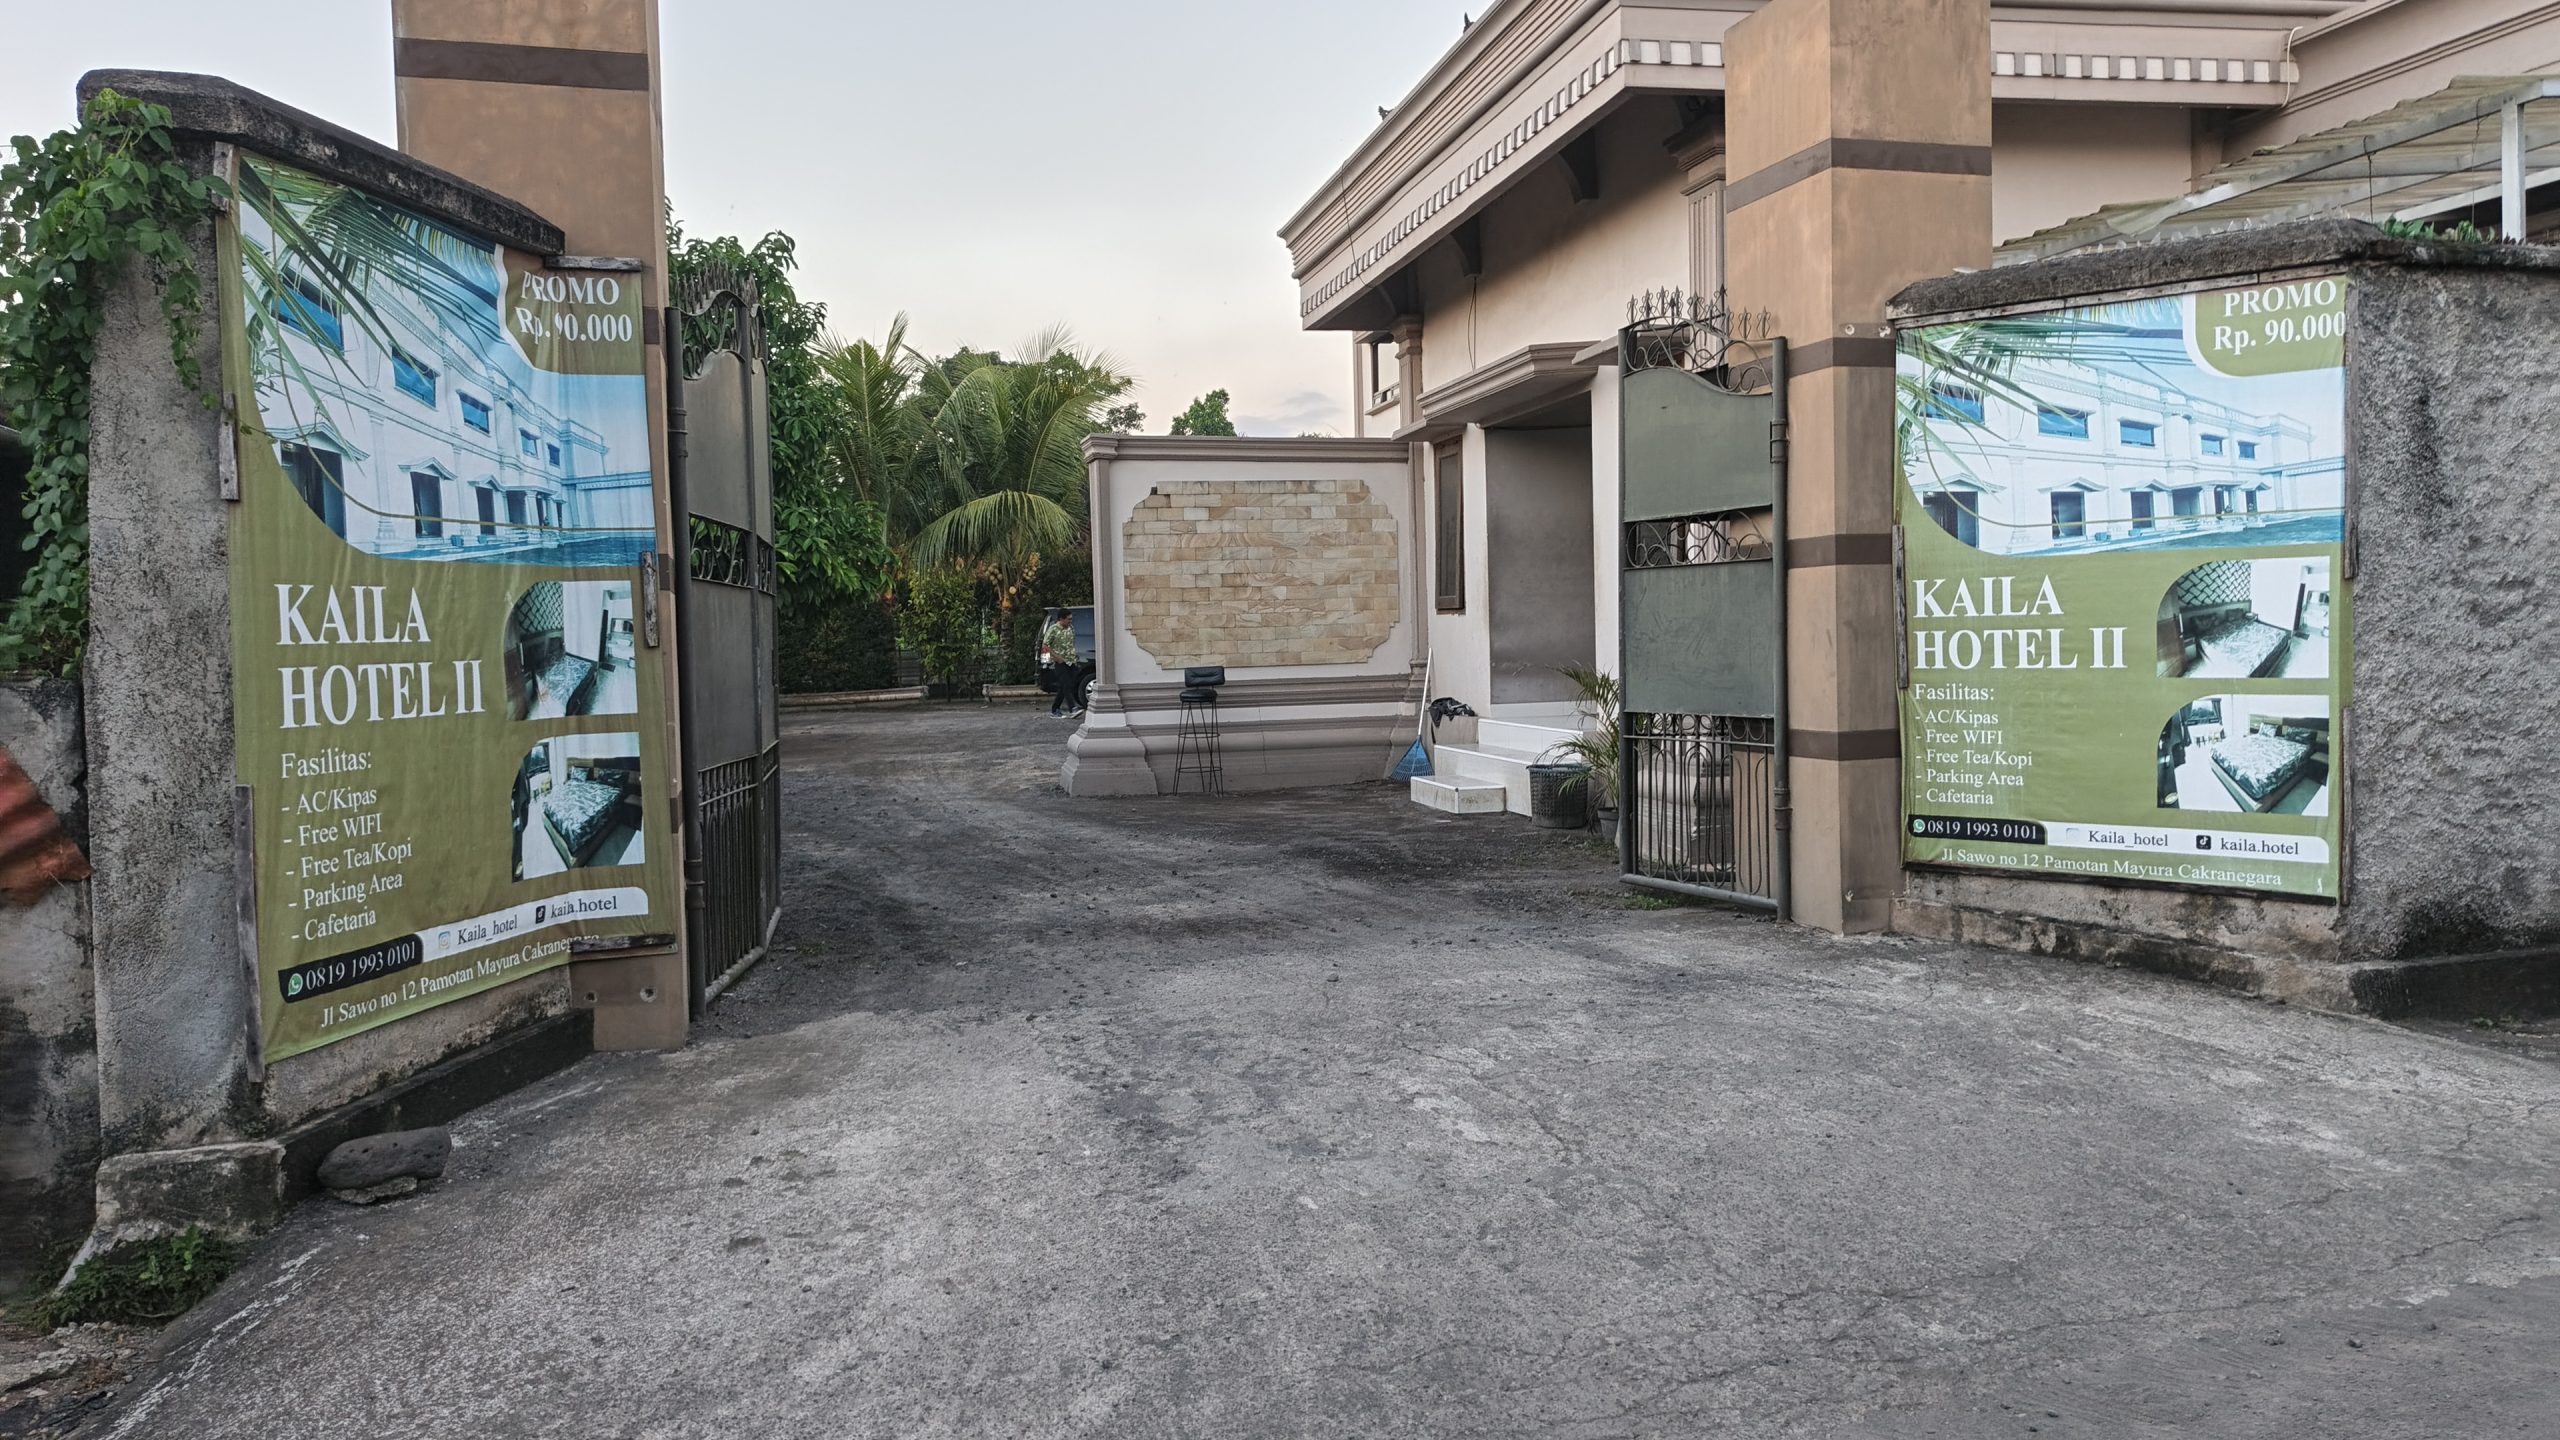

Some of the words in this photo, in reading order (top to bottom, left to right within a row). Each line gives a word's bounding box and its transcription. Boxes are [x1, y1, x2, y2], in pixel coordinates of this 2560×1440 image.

[521, 270, 620, 305] PROMO
[2223, 279, 2337, 317] PROMO
[514, 307, 551, 344] Rp.
[554, 312, 633, 342] 90.000
[2213, 325, 2257, 355] Rp.
[2264, 311, 2347, 345] 90.000
[1912, 574, 2065, 619] KAILA
[274, 583, 431, 646] KAILA
[1913, 627, 2078, 670] HOTEL
[2089, 626, 2128, 669] II
[277, 661, 446, 729] HOTEL
[452, 659, 486, 715] II
[1914, 683, 1995, 701] Fasilitas:
[1925, 709, 1999, 727] AC/Kipas
[1926, 729, 1958, 743] Free
[1963, 729, 2003, 745] WIFI
[281, 747, 372, 779] Fasilitas:
[1926, 749, 1959, 763] Free
[1962, 749, 2033, 769] Tea/Kopi
[1927, 768, 1984, 788] Parking
[1987, 771, 2024, 786] Area
[296, 786, 377, 815] AC/Kipas
[1926, 787, 1994, 805] Cafetaria
[298, 824, 339, 847] Free
[342, 812, 383, 838] WIFI
[1927, 819, 1961, 835] 0819
[1966, 822, 1999, 837] 1993
[2003, 824, 2037, 840] 0101
[2088, 830, 2169, 848] Kaila_hotel
[2220, 837, 2299, 855] kaila.hotel
[301, 856, 340, 879] Free
[343, 836, 412, 870] Tea/Kopi
[1957, 849, 1996, 864] Sawo
[1999, 855, 2018, 866] no
[2023, 854, 2039, 868] 12
[2044, 856, 2109, 873] Pamotan
[2113, 859, 2173, 880] Mayura
[2178, 863, 2282, 886] Cakranegara
[304, 879, 367, 910] Parking
[368, 873, 403, 894] Area
[304, 905, 377, 941] Cafetaria
[457, 915, 518, 945] Kaila_hotel
[305, 962, 345, 990] 0819
[351, 951, 384, 978] 1993
[387, 941, 415, 967] 0101
[339, 999, 377, 1022] Sawo
[380, 991, 397, 1005] no
[402, 981, 417, 1001] 12
[420, 966, 475, 995] Pamotan
[476, 952, 521, 979] Mayura
